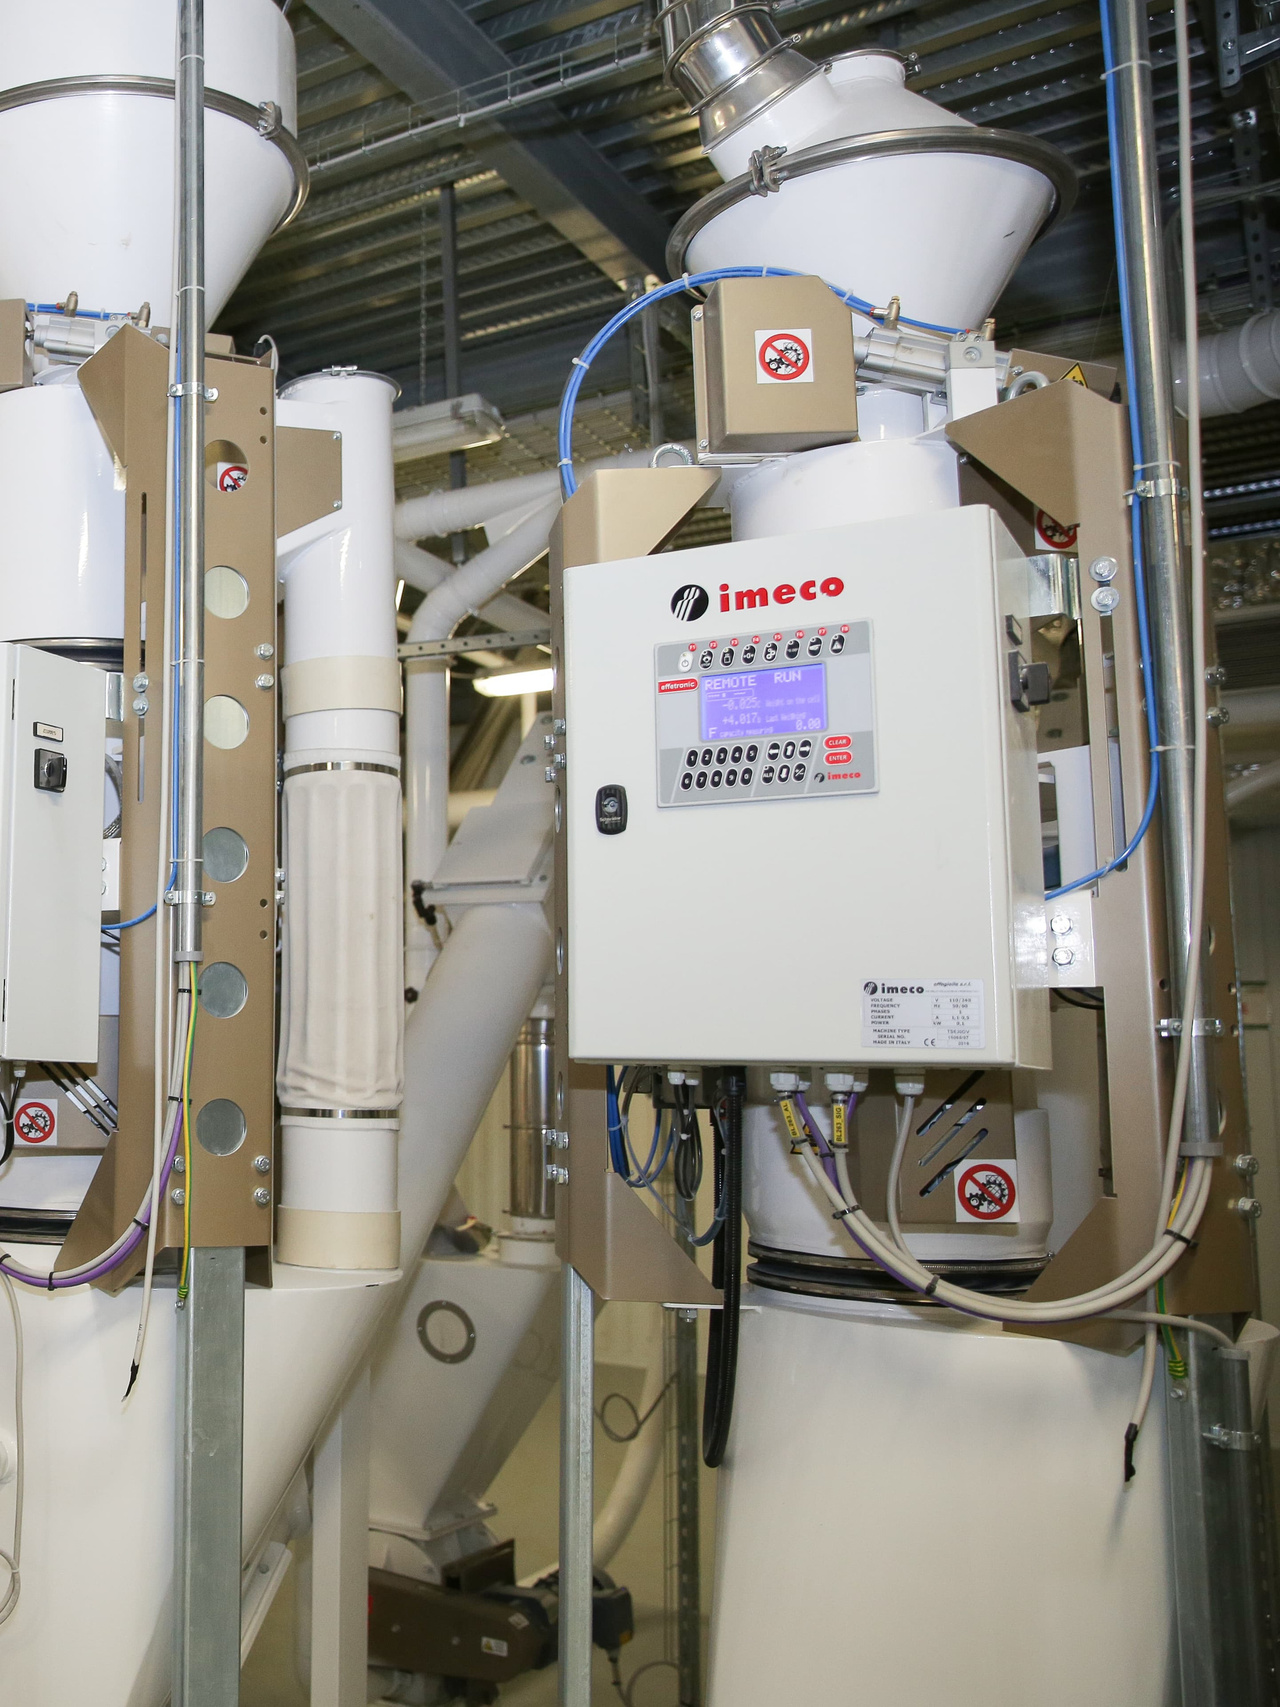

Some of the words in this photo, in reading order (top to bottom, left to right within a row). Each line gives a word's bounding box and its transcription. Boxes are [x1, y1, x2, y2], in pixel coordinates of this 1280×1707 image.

[719, 576, 845, 613] imeco
[661, 680, 696, 690] effetronic
[704, 675, 757, 690] REMOTE
[773, 671, 801, 683] RUN
[827, 772, 861, 780] imeco
[881, 983, 924, 994] imeco
